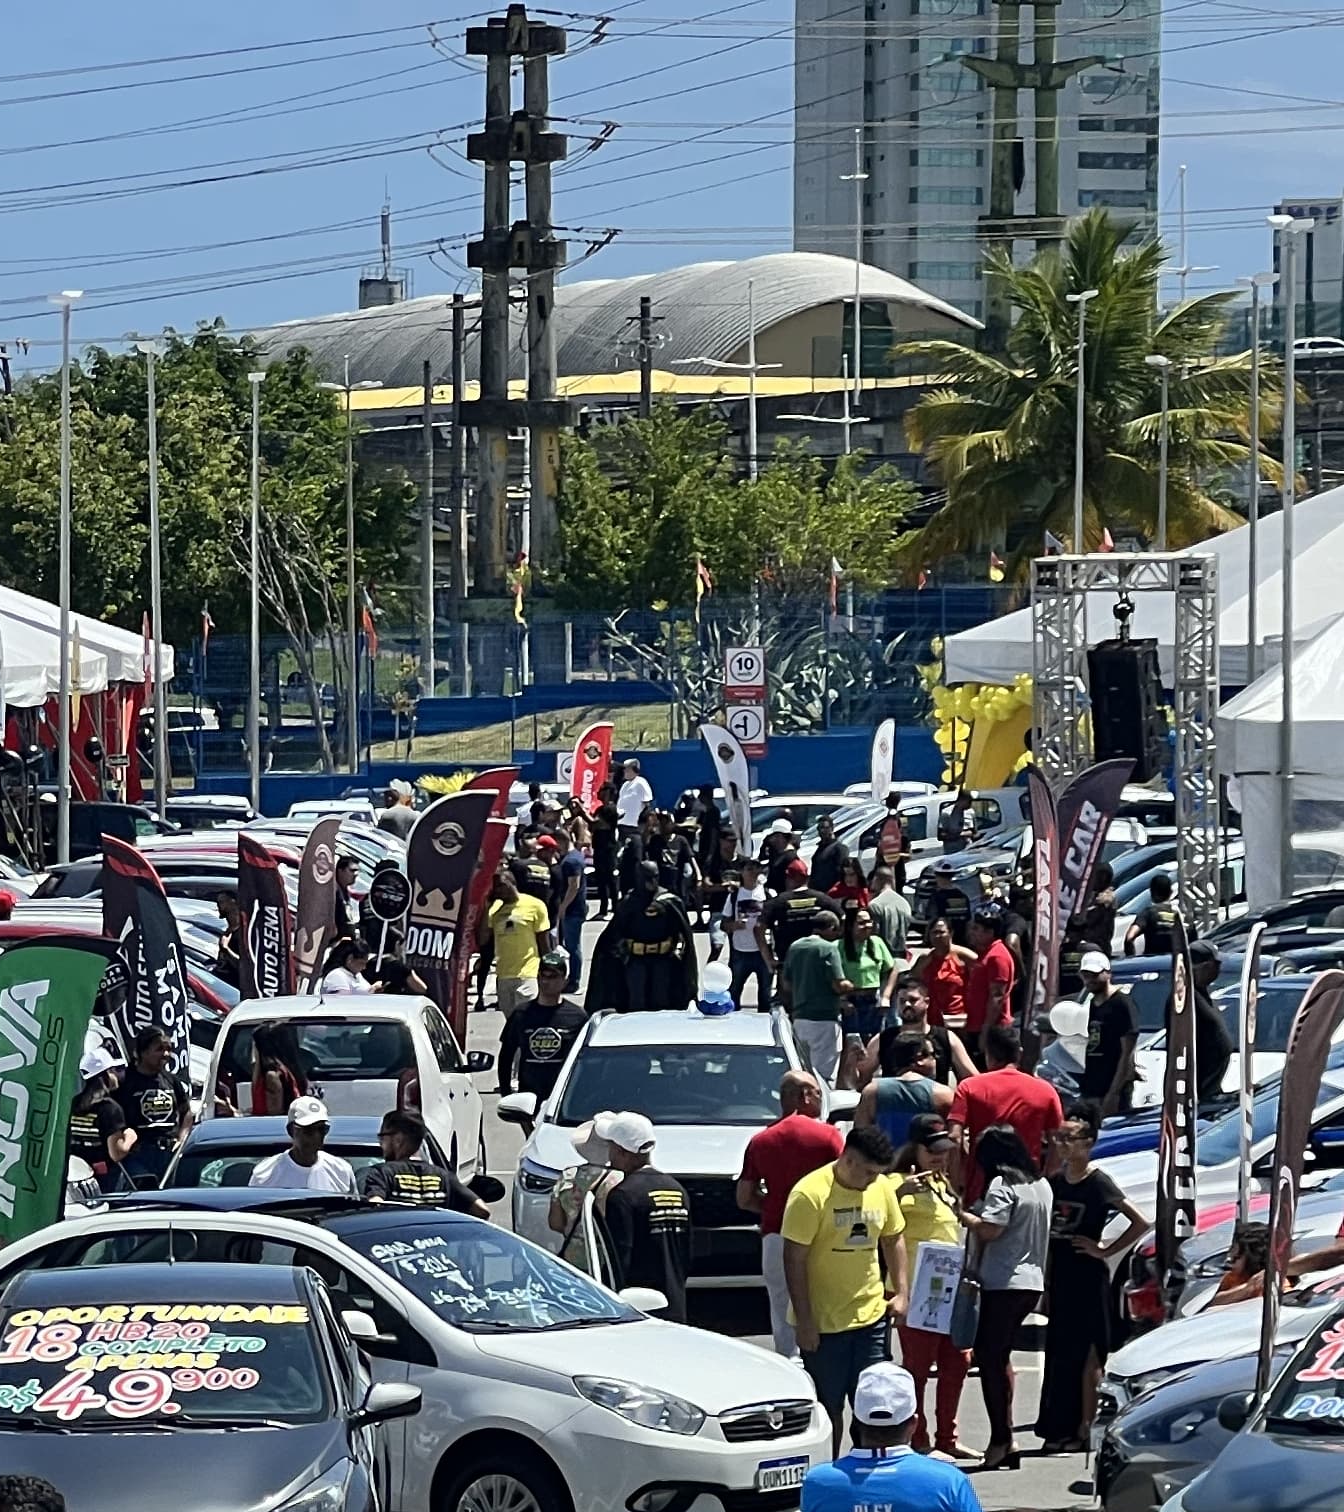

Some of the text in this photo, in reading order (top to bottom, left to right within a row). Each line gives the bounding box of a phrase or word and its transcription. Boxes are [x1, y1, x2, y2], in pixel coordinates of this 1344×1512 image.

[736, 657, 754, 671] 10
[1064, 800, 1102, 880] CAR
[263, 905, 279, 998] AUTO SENA
[407, 926, 455, 960] DOM
[8, 1304, 311, 1327] OPORTUNIDADE
[77, 1334, 268, 1354] COMPLETO
[65, 1351, 221, 1373] APENAS
